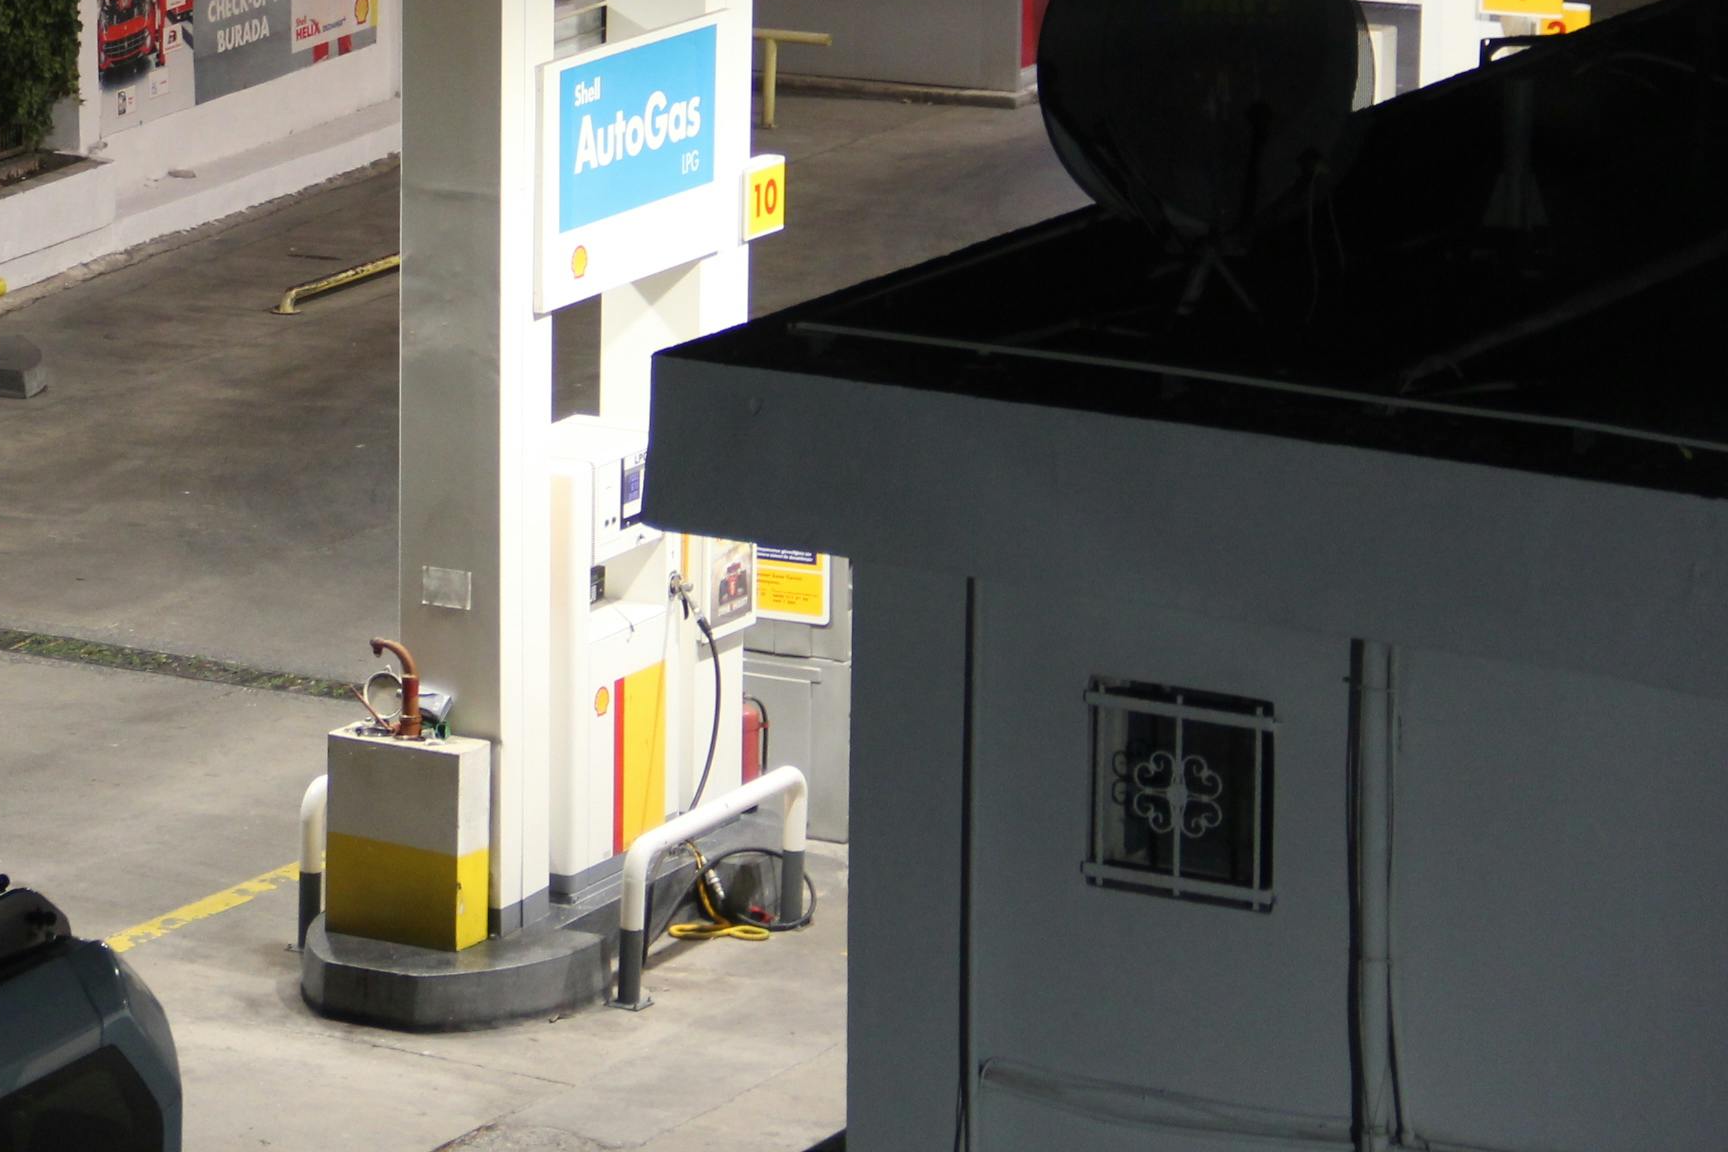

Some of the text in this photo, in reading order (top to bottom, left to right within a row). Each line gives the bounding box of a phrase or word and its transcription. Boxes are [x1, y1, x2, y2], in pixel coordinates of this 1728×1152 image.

[216, 15, 270, 53] BURADA
[295, 19, 321, 41] HELIX
[574, 76, 602, 108] Shell
[573, 90, 701, 175] AutoGas
[681, 149, 700, 176] LPG
[754, 178, 778, 218] 10
